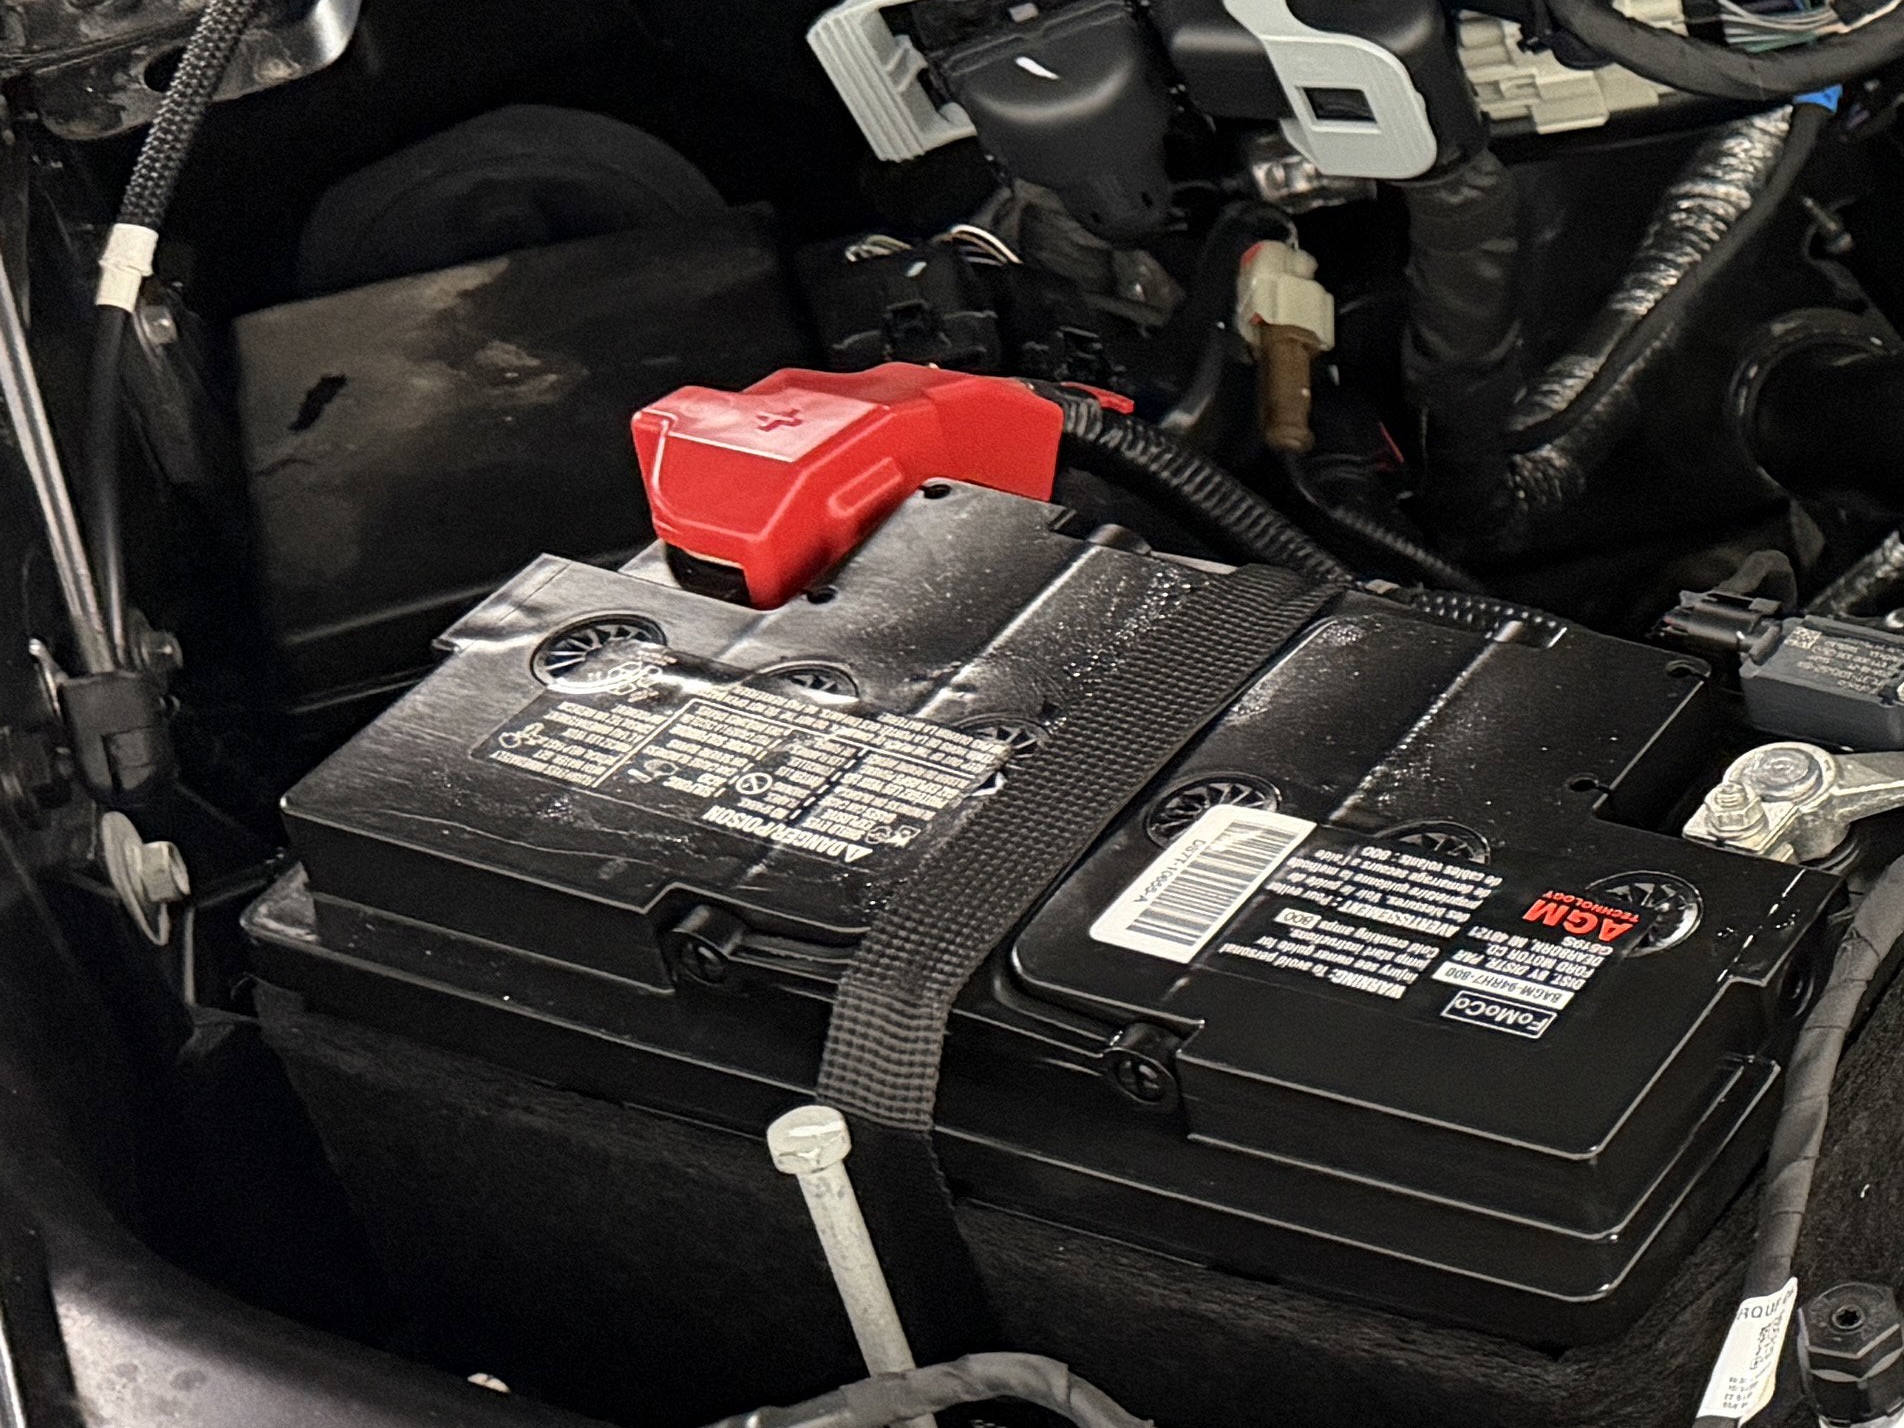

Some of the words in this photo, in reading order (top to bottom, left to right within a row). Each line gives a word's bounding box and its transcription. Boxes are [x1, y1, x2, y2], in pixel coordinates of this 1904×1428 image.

[697, 803, 851, 857] DANGER/POISON
[1302, 873, 1343, 892] guide
[1481, 874, 1504, 887] de
[1300, 889, 1335, 905] Pour
[1351, 887, 1383, 902] Voir
[1537, 888, 1646, 922] TECHNOLOGY
[1281, 910, 1315, 926] 800
[1334, 899, 1461, 938] AVERTISSEMENT
[1443, 908, 1472, 923] des
[1518, 898, 1637, 944] AGM
[1316, 917, 1358, 935] amps
[1252, 934, 1279, 948] for
[1350, 926, 1412, 950] cranking
[1505, 934, 1530, 948] MI
[1216, 940, 1279, 964] personal
[1272, 937, 1317, 958] guide
[1311, 948, 1356, 965] owner
[1359, 945, 1396, 961] start
[1405, 941, 1442, 958] Cold
[1449, 948, 1485, 965] PAR
[1480, 942, 1510, 957] CO.
[1272, 955, 1314, 973] avoid
[1352, 957, 1381, 971] see
[1391, 951, 1432, 969] jump
[1480, 956, 1531, 976] DISTR.
[1505, 948, 1558, 969] MOTOR
[1308, 963, 1330, 976] To
[1375, 963, 1421, 984] injury
[1525, 966, 1551, 981] BY
[1553, 960, 1597, 978] FORD
[1322, 967, 1411, 999] WARNING:
[1546, 972, 1587, 990] DIST.
[1447, 995, 1551, 1032] FoMoCo
